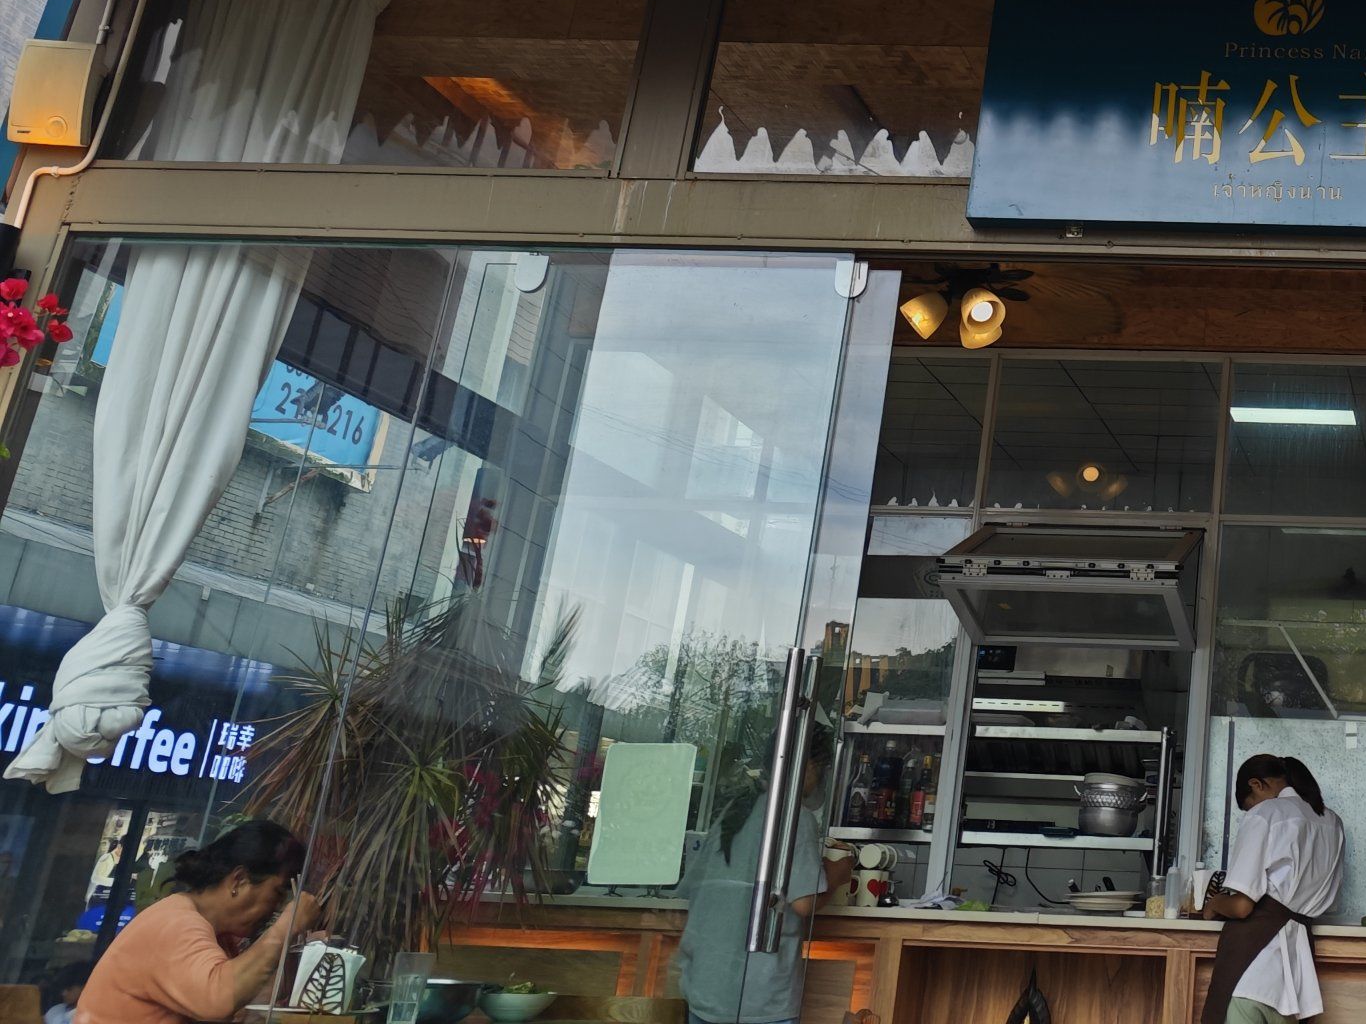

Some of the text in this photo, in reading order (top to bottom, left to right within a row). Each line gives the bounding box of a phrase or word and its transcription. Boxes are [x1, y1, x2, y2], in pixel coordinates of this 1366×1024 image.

[1225, 41, 1324, 60] Princess
[218, 722, 256, 751] 瑞幸
[209, 755, 247, 783] 咖啡
